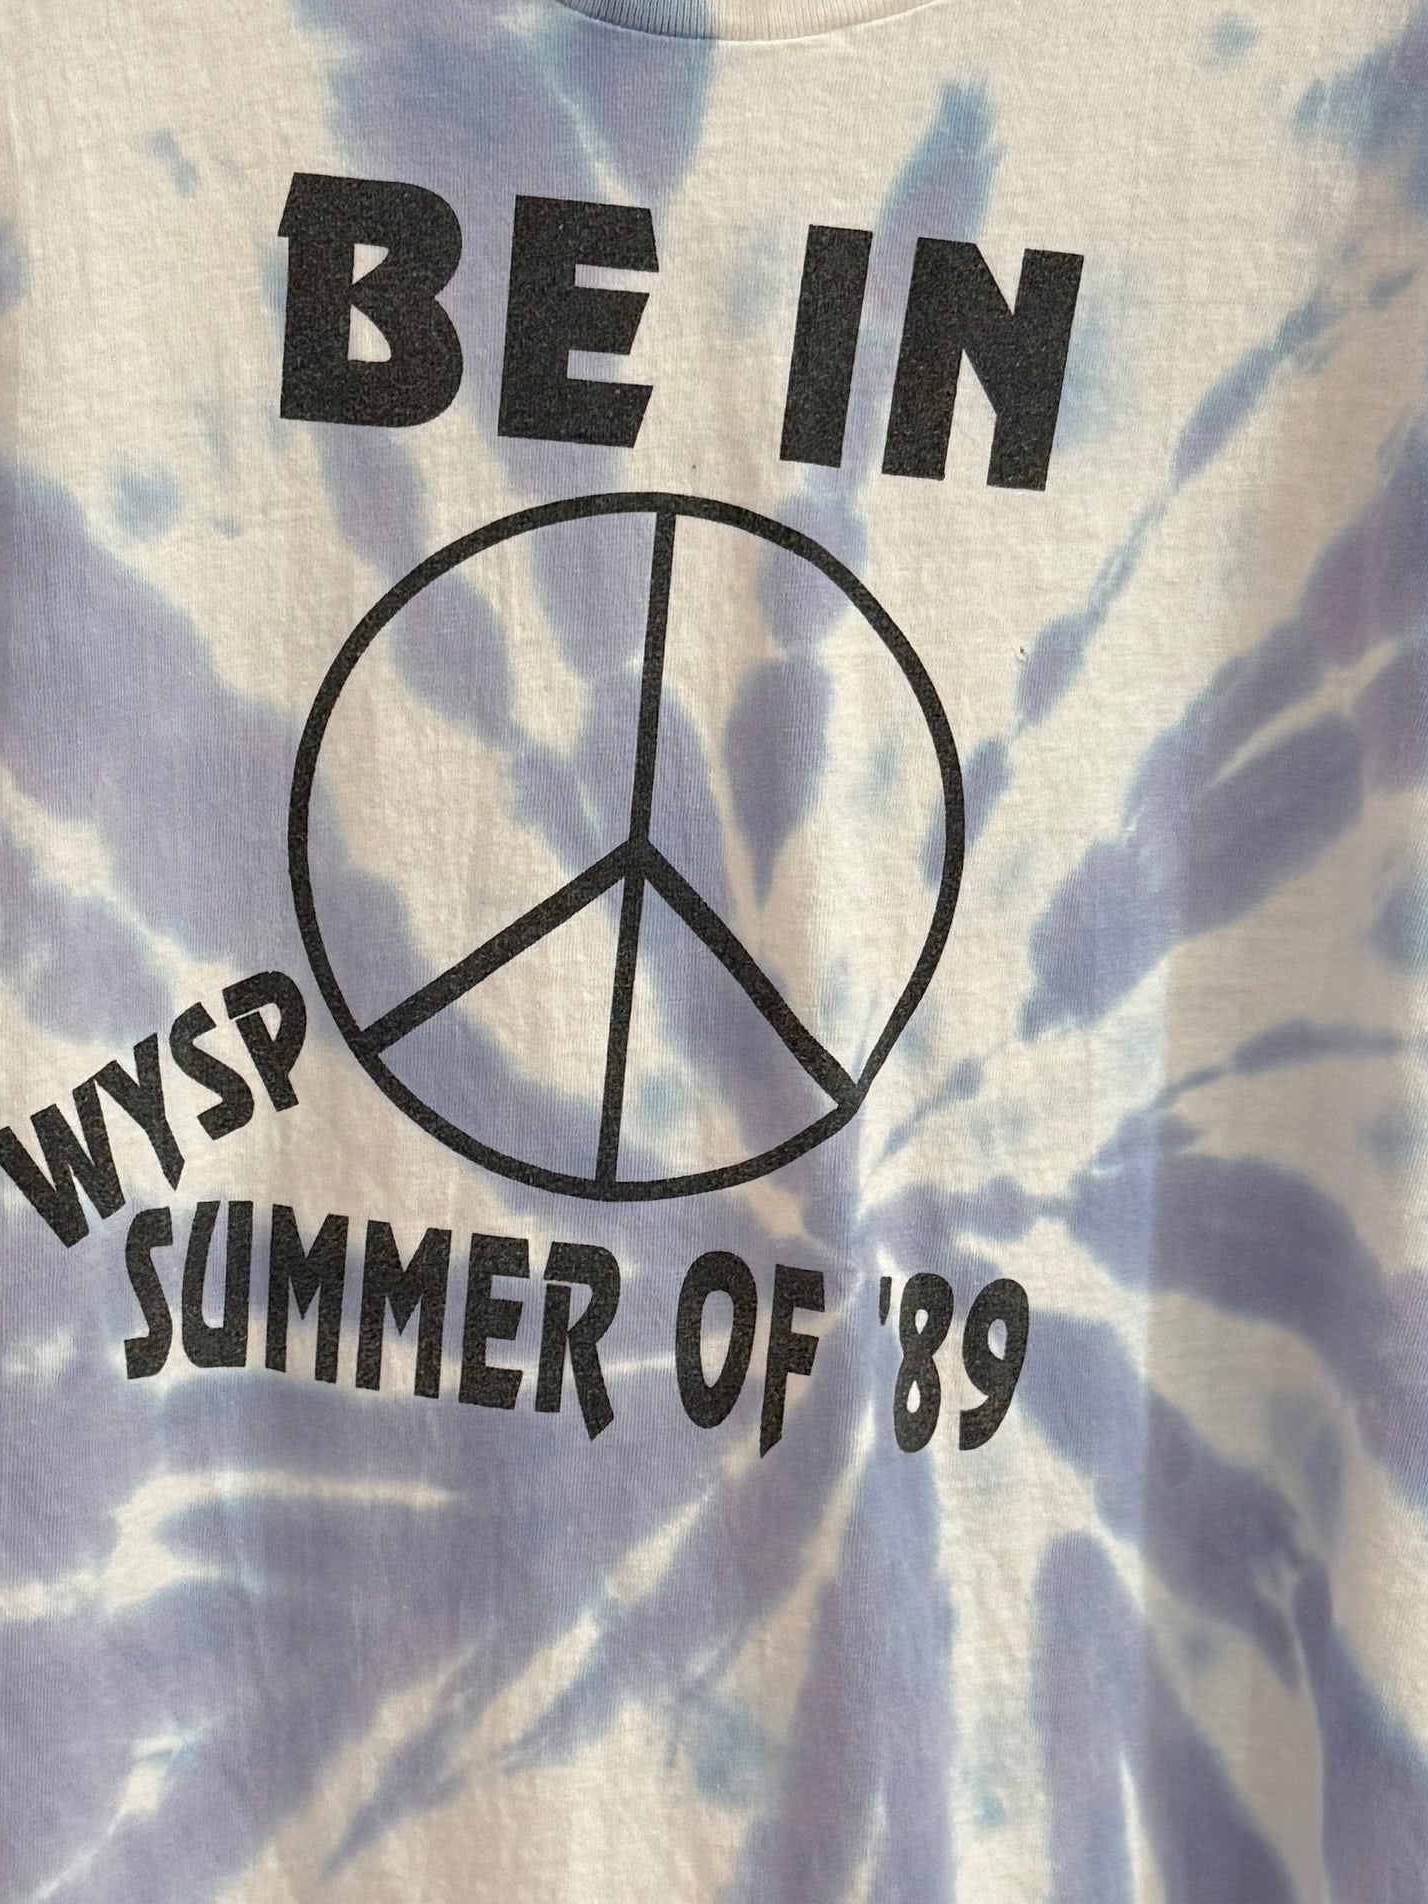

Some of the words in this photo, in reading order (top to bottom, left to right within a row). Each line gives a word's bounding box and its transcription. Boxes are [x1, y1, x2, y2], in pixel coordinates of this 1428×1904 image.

[278, 172, 660, 449] BE
[779, 224, 1085, 491] IN
[124, 1200, 621, 1441] SUMMER
[675, 1251, 826, 1458] OF
[878, 1272, 1030, 1453] '89
